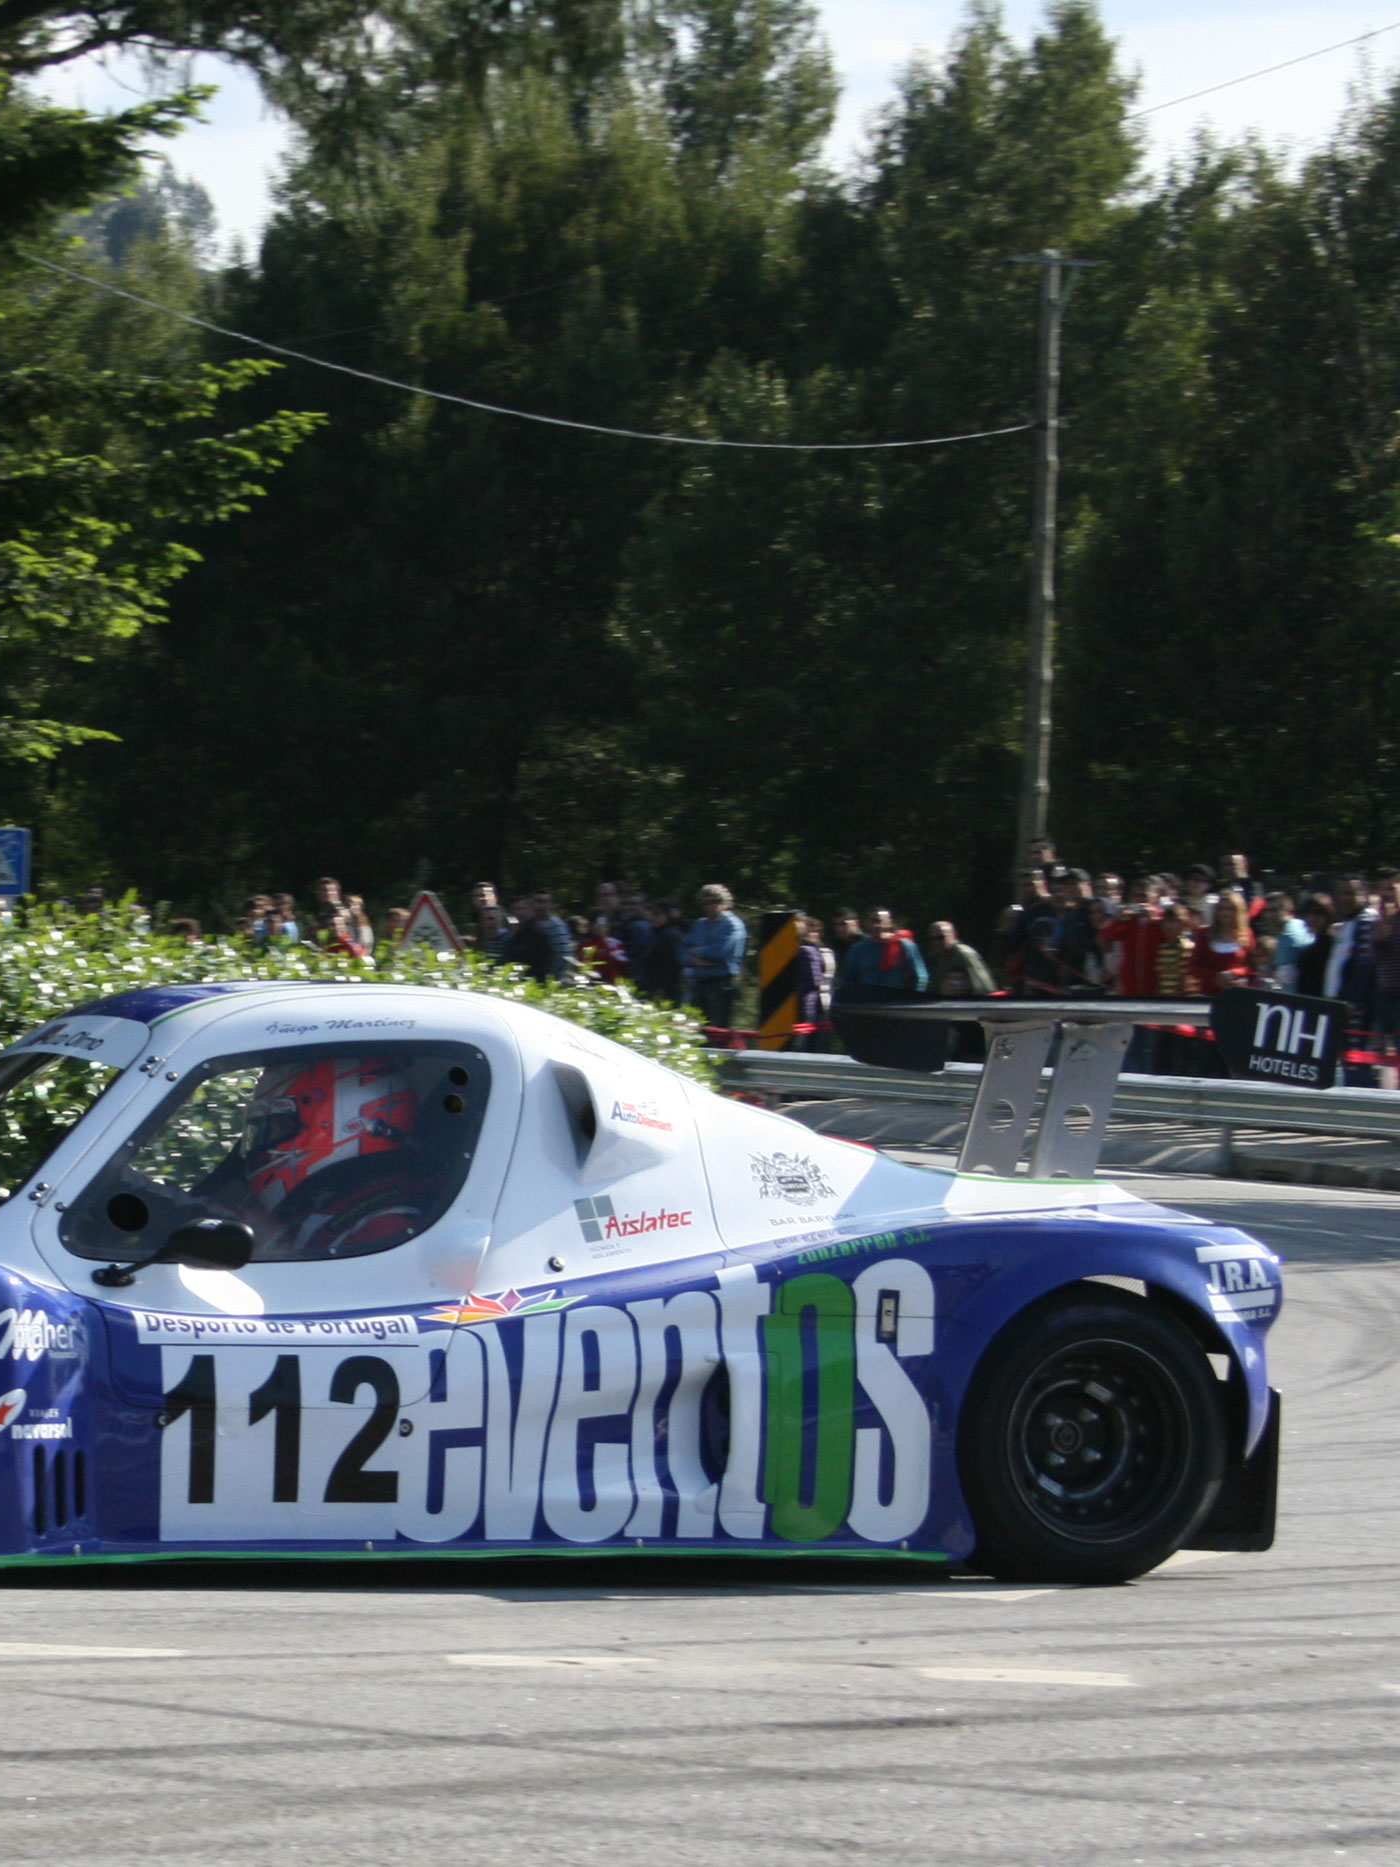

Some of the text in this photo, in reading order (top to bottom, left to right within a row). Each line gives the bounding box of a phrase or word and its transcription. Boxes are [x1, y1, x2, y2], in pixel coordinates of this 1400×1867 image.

[1248, 1054, 1319, 1082] HOTELES
[604, 1208, 693, 1239] Aislatec
[769, 1217, 796, 1227] BAR
[1205, 1259, 1273, 1294] J.R.A.
[145, 1313, 409, 1340] Desporto de Portugal
[164, 1354, 401, 1504] 112
